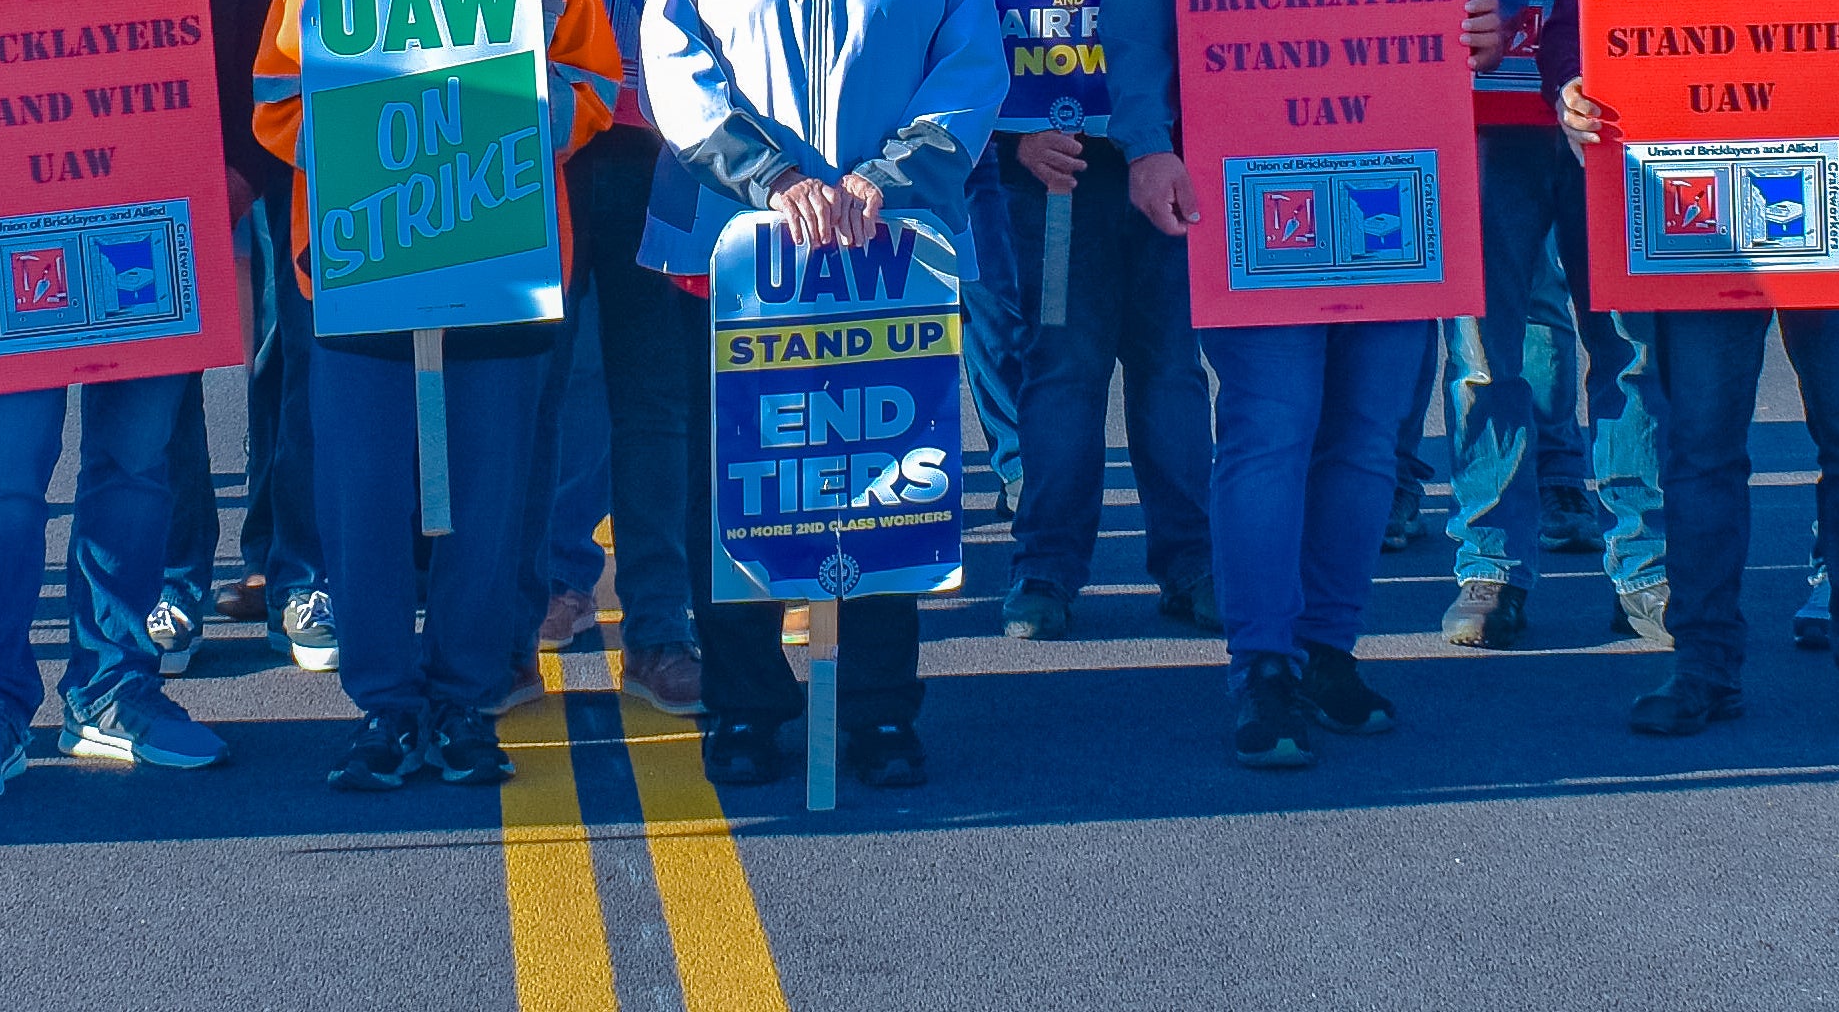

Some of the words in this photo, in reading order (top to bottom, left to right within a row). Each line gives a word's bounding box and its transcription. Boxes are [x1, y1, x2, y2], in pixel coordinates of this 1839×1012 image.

[1002, 7, 1070, 38] AIR
[1607, 26, 1735, 57] STAND
[1205, 41, 1331, 72] STAND
[1346, 34, 1444, 64] WITH
[88, 79, 192, 119] WITH
[1286, 95, 1370, 127] UAW
[1689, 82, 1775, 112] UAW
[376, 76, 461, 172] ON
[29, 147, 116, 185] UAW
[1247, 161, 1280, 172] Union
[1283, 159, 1294, 169] of
[1295, 158, 1356, 170] Bricklayers
[1360, 157, 1380, 166] and
[1383, 155, 1415, 165] Allied
[1648, 147, 1682, 157] Union
[1685, 146, 1696, 156] of
[1698, 144, 1759, 157] Bricklayers
[1763, 144, 1784, 154] and
[1787, 143, 1819, 153] Allied
[30, 219, 42, 229] of
[43, 213, 106, 227] Bricklayers
[110, 209, 131, 220] and
[134, 206, 165, 217] Allied
[322, 126, 541, 281] STRIKE
[1424, 174, 1435, 262] Craftworkers
[1630, 168, 1642, 252] International
[1827, 162, 1839, 250] Craftworkers
[1232, 183, 1242, 268] International
[176, 223, 192, 314] Craftworkers
[754, 222, 916, 306] UAW
[729, 328, 872, 367] STAND
[887, 320, 945, 354] UP
[759, 384, 916, 448] END
[728, 446, 949, 517] TIERS
[727, 528, 747, 540] NO
[751, 524, 792, 537] MORE
[796, 522, 824, 534] 2ND
[829, 518, 876, 531] CLASS
[879, 511, 952, 528] WORKERS
